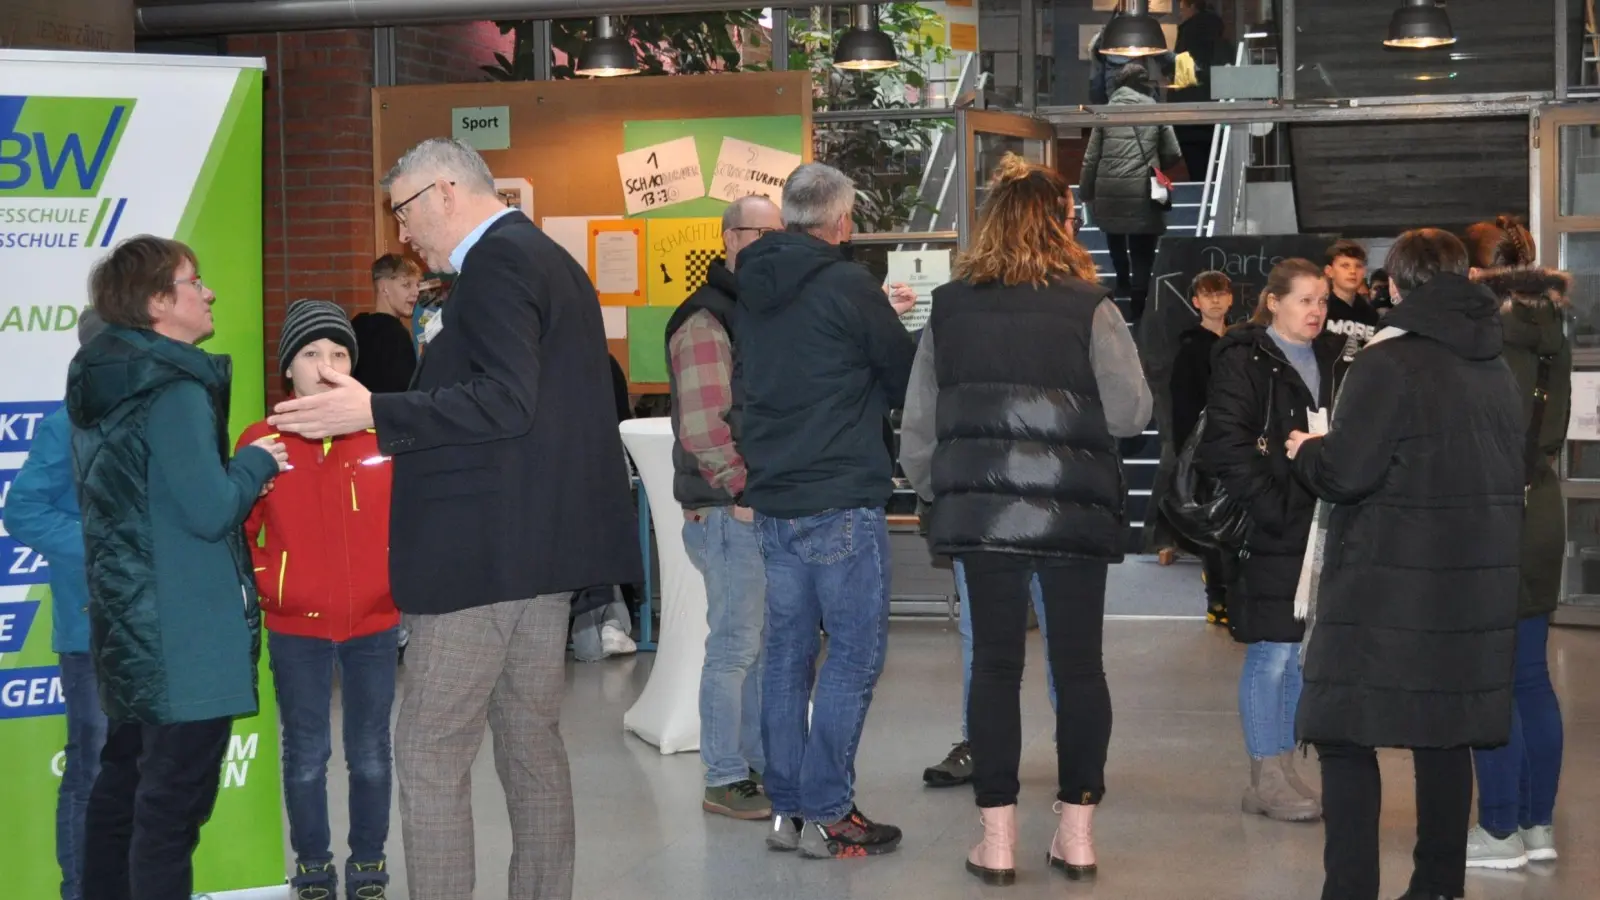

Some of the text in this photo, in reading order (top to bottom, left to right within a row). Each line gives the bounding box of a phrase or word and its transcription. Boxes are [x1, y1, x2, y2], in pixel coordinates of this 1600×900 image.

[462, 116, 499, 131] Sport
[645, 152, 658, 169] 1
[0, 304, 94, 332] AND
